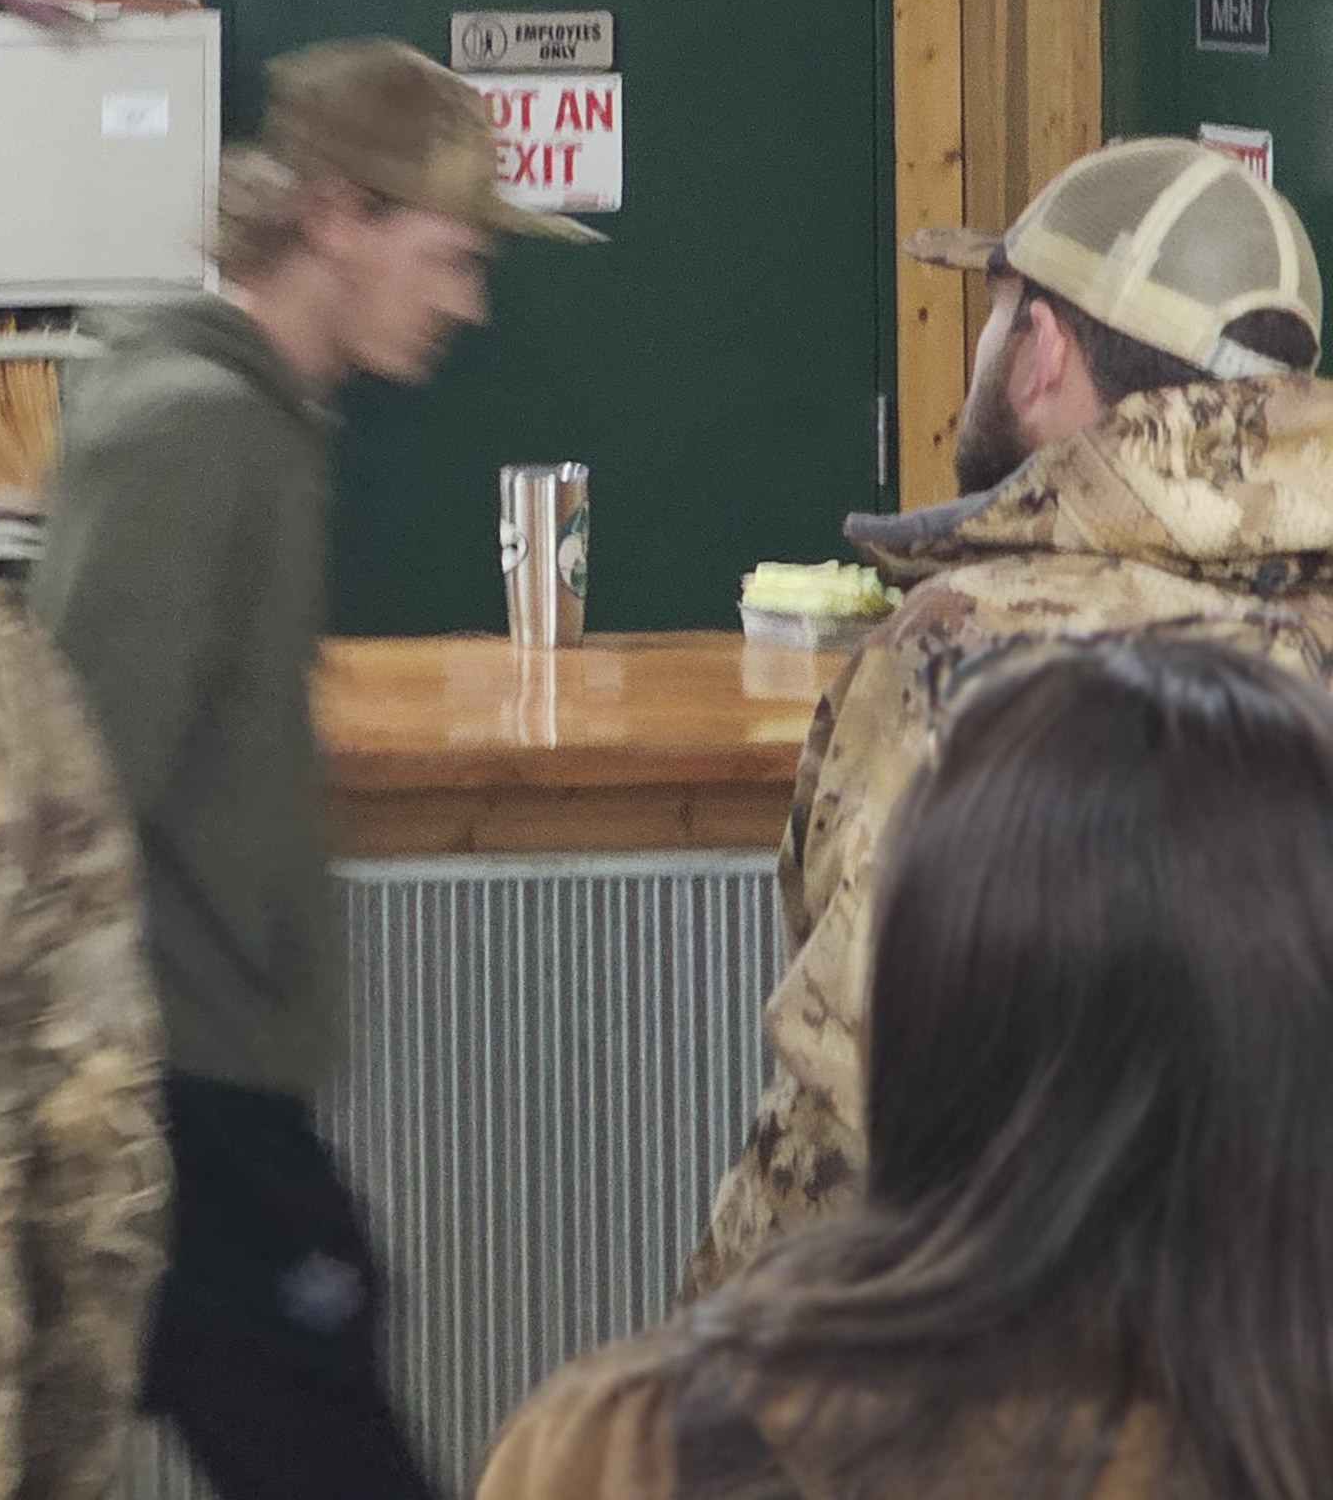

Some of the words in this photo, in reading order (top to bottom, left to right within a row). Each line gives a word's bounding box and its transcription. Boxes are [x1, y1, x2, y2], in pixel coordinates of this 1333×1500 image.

[515, 24, 602, 43] EMPLOYEES
[539, 44, 577, 60] ONLY
[482, 87, 540, 132] OT
[554, 87, 614, 132] AN
[491, 140, 583, 185] EXIT
